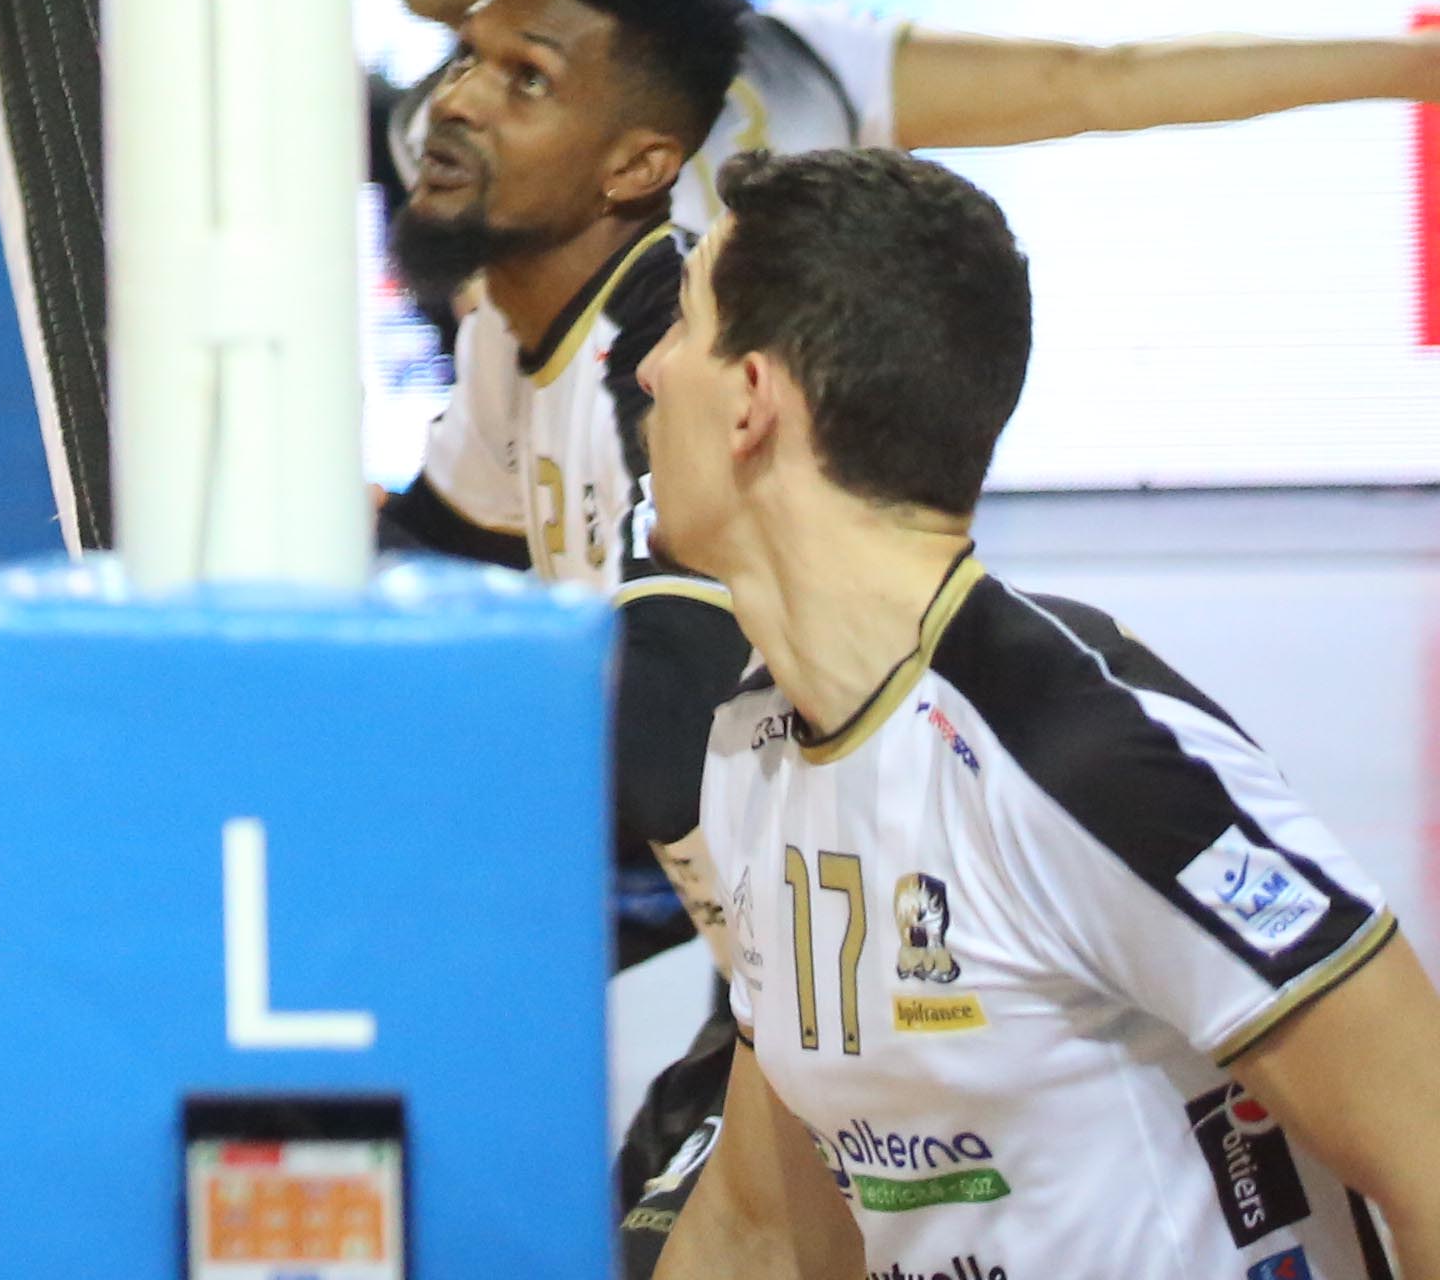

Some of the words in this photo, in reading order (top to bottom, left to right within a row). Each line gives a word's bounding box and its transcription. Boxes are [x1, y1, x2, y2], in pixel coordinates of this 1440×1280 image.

[222, 817, 378, 1051] L
[782, 843, 868, 1057] 17
[837, 1119, 993, 1170] alterna
